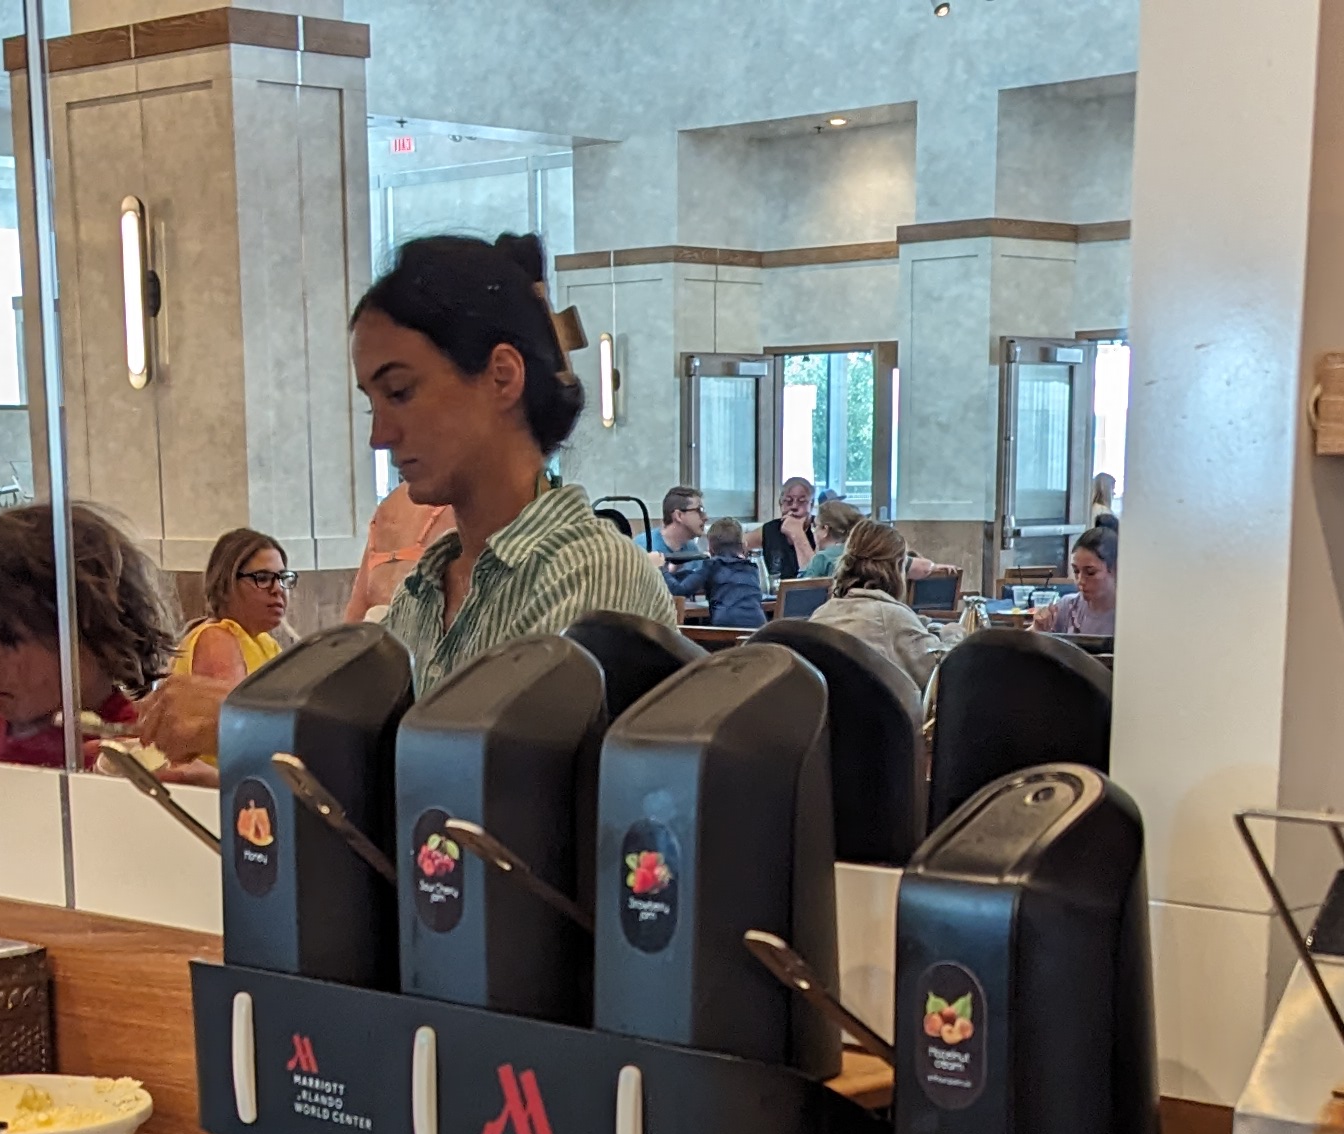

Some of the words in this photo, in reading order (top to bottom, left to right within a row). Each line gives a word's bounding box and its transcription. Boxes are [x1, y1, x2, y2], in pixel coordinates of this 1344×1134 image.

[293, 1074, 345, 1096] MARRIOTT
[294, 1102, 330, 1120] WORLD
[332, 1110, 373, 1131] CENTER
